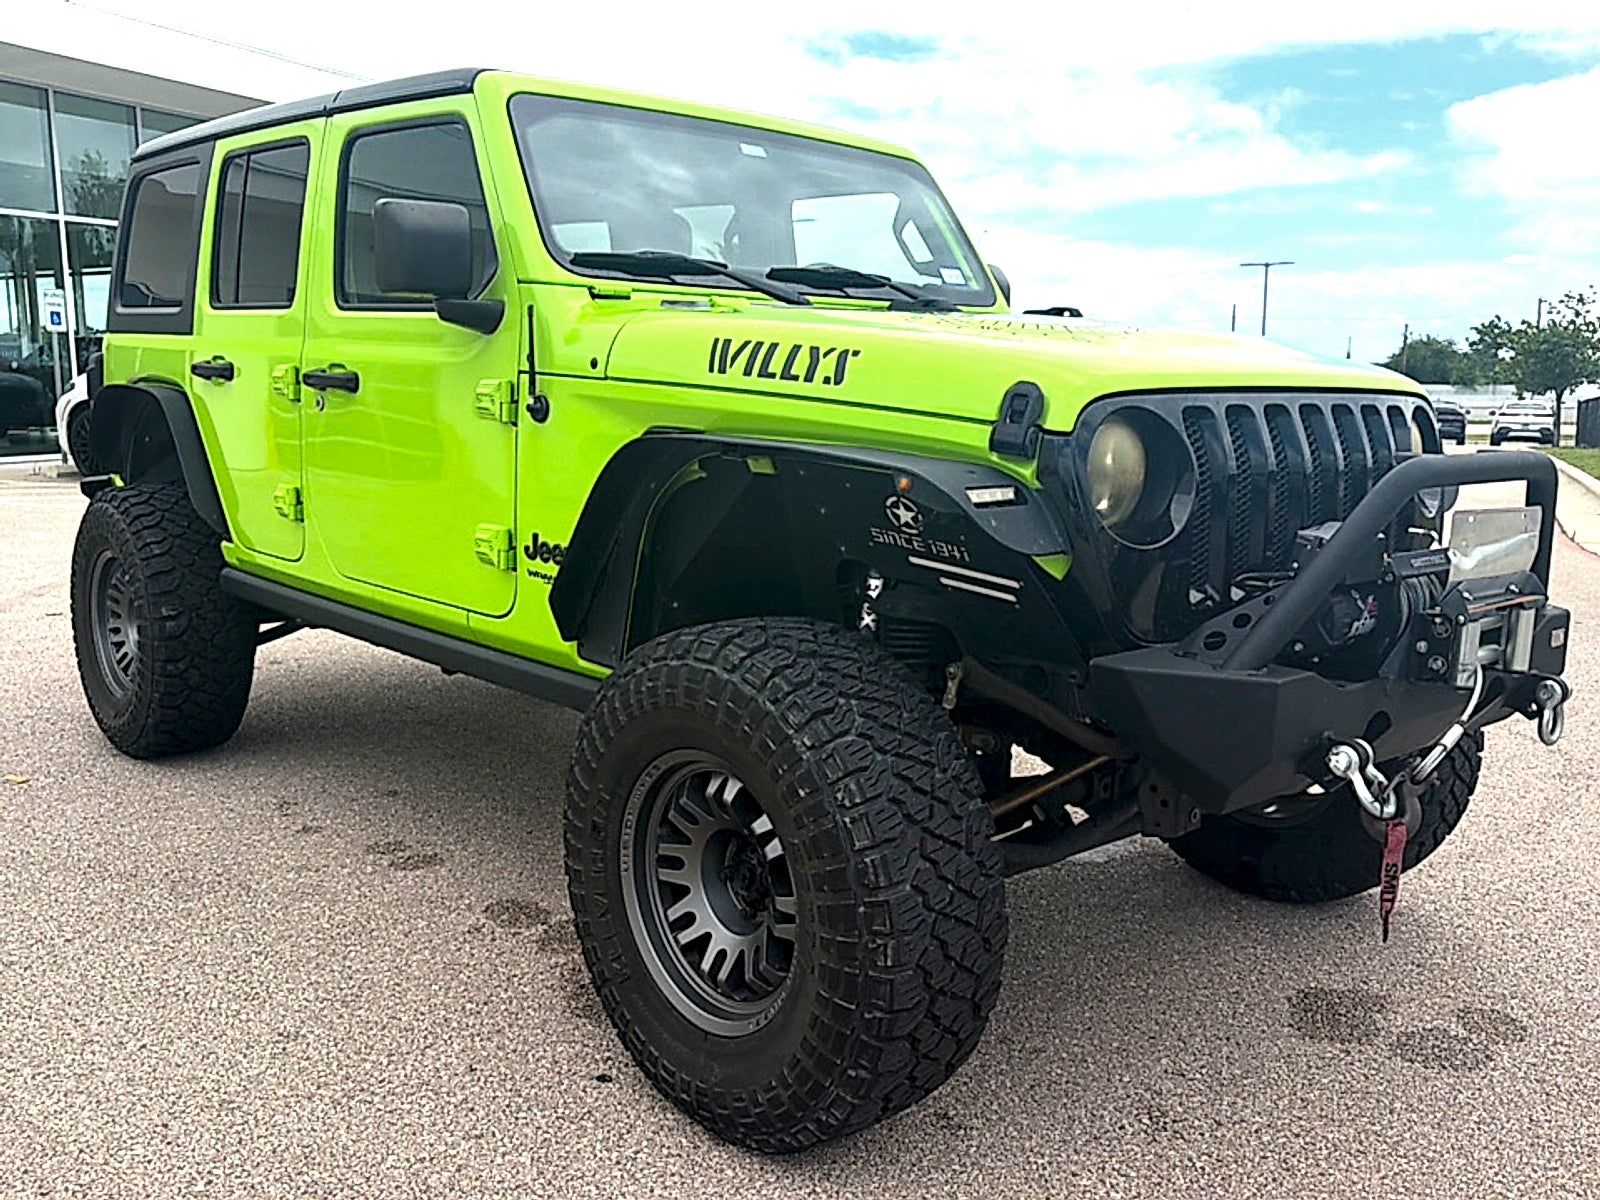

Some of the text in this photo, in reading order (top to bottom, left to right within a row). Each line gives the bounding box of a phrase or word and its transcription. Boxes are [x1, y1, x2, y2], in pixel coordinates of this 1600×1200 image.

[708, 337, 861, 386] WILLYS
[523, 532, 568, 566] Jee
[929, 539, 970, 562] 1941
